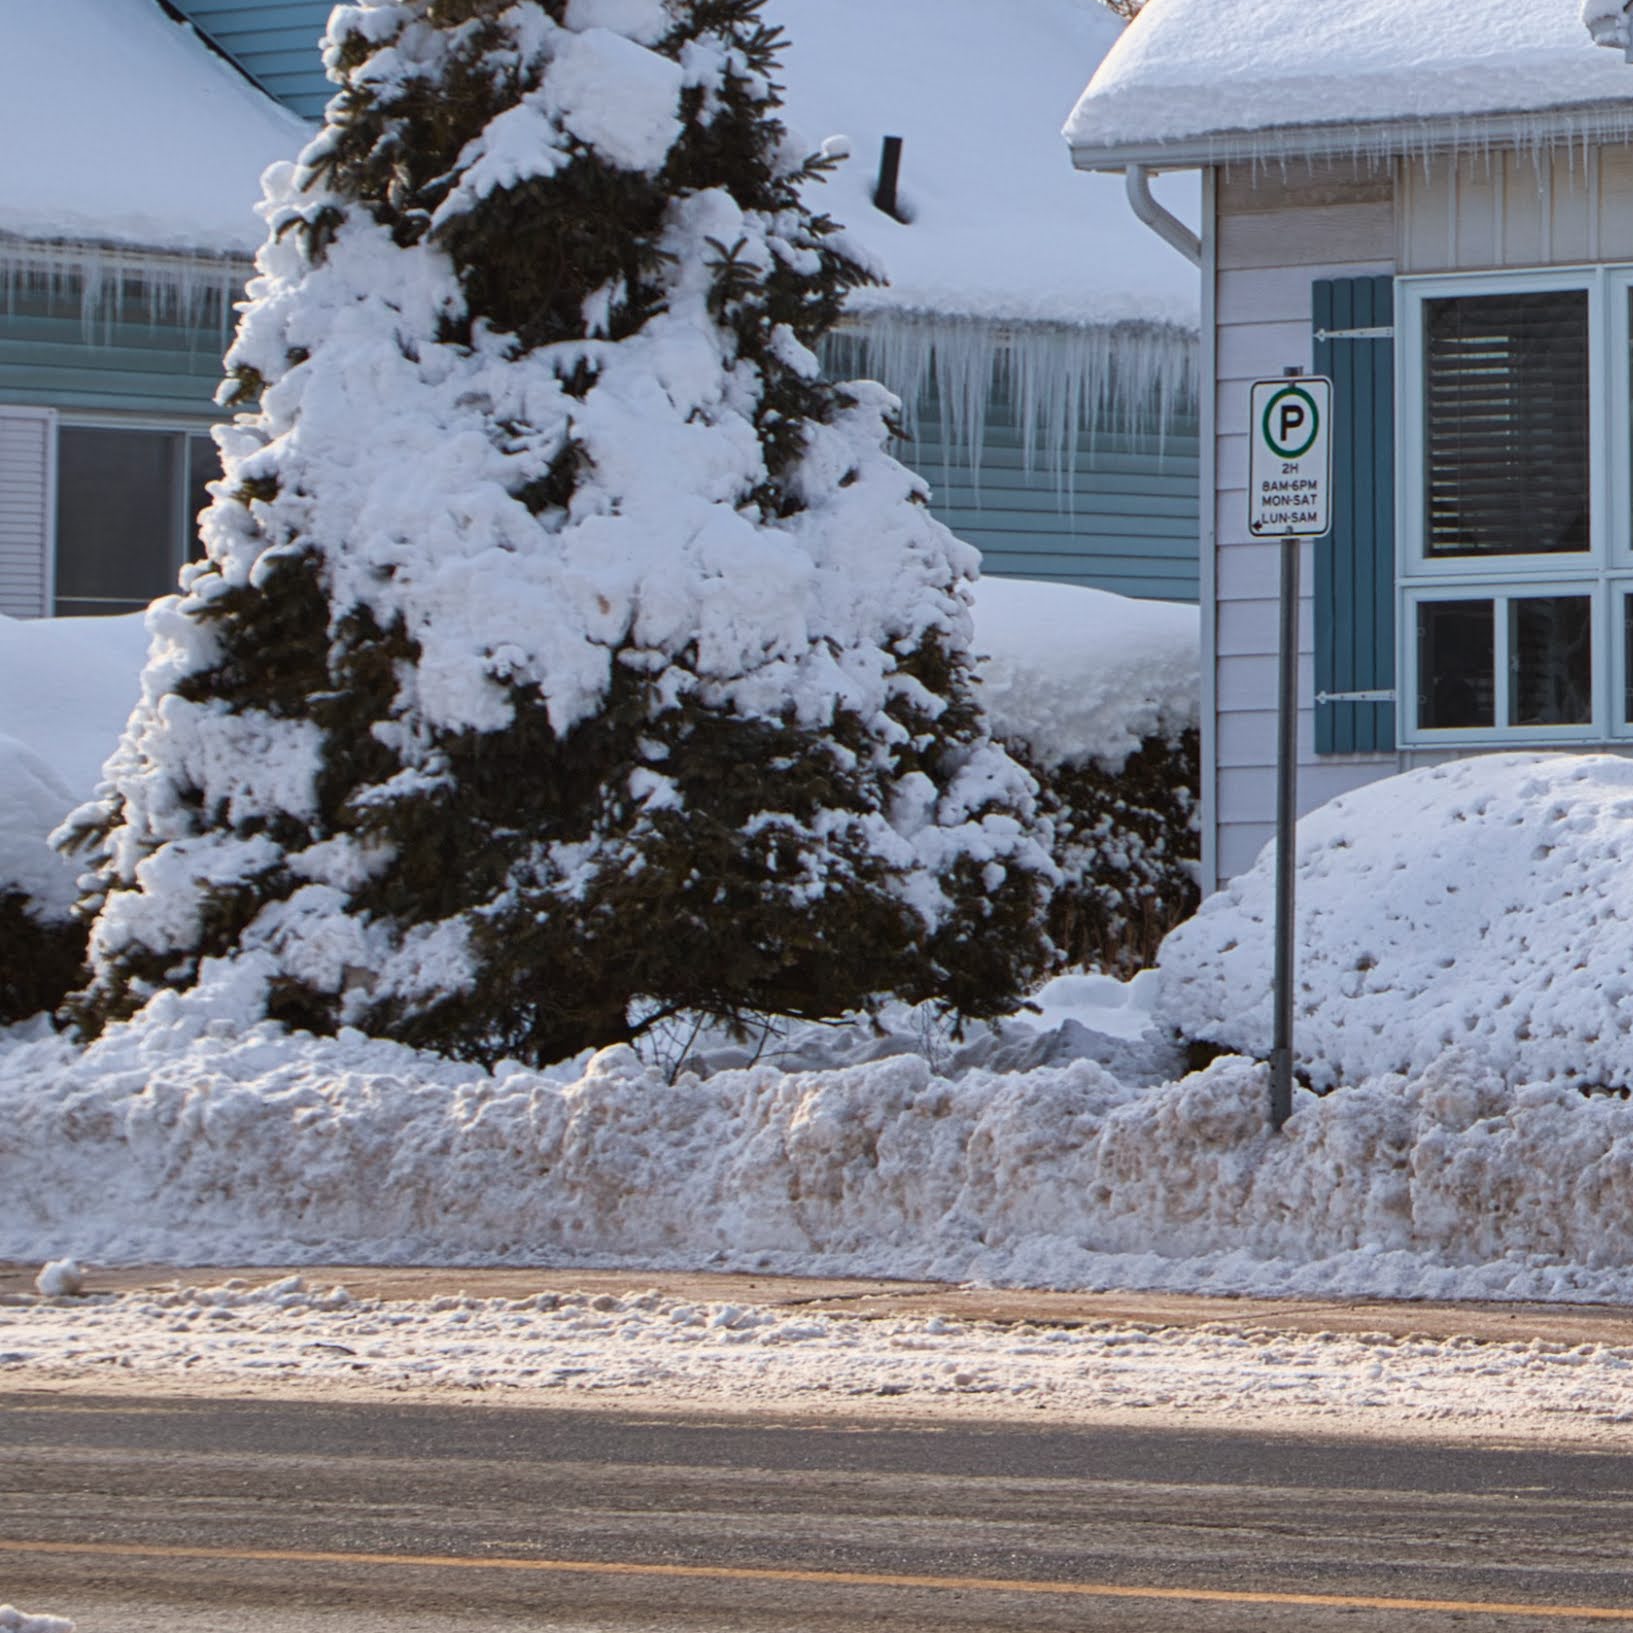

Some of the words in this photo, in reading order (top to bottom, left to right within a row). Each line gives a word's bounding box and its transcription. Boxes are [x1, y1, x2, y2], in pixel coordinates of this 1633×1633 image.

[1280, 404, 1304, 442] P
[1281, 463, 1299, 475] 2H
[1261, 479, 1318, 492] 8AM-6PM
[1261, 494, 1318, 507] MON-SAT
[1261, 512, 1318, 525] LUN-SAM
